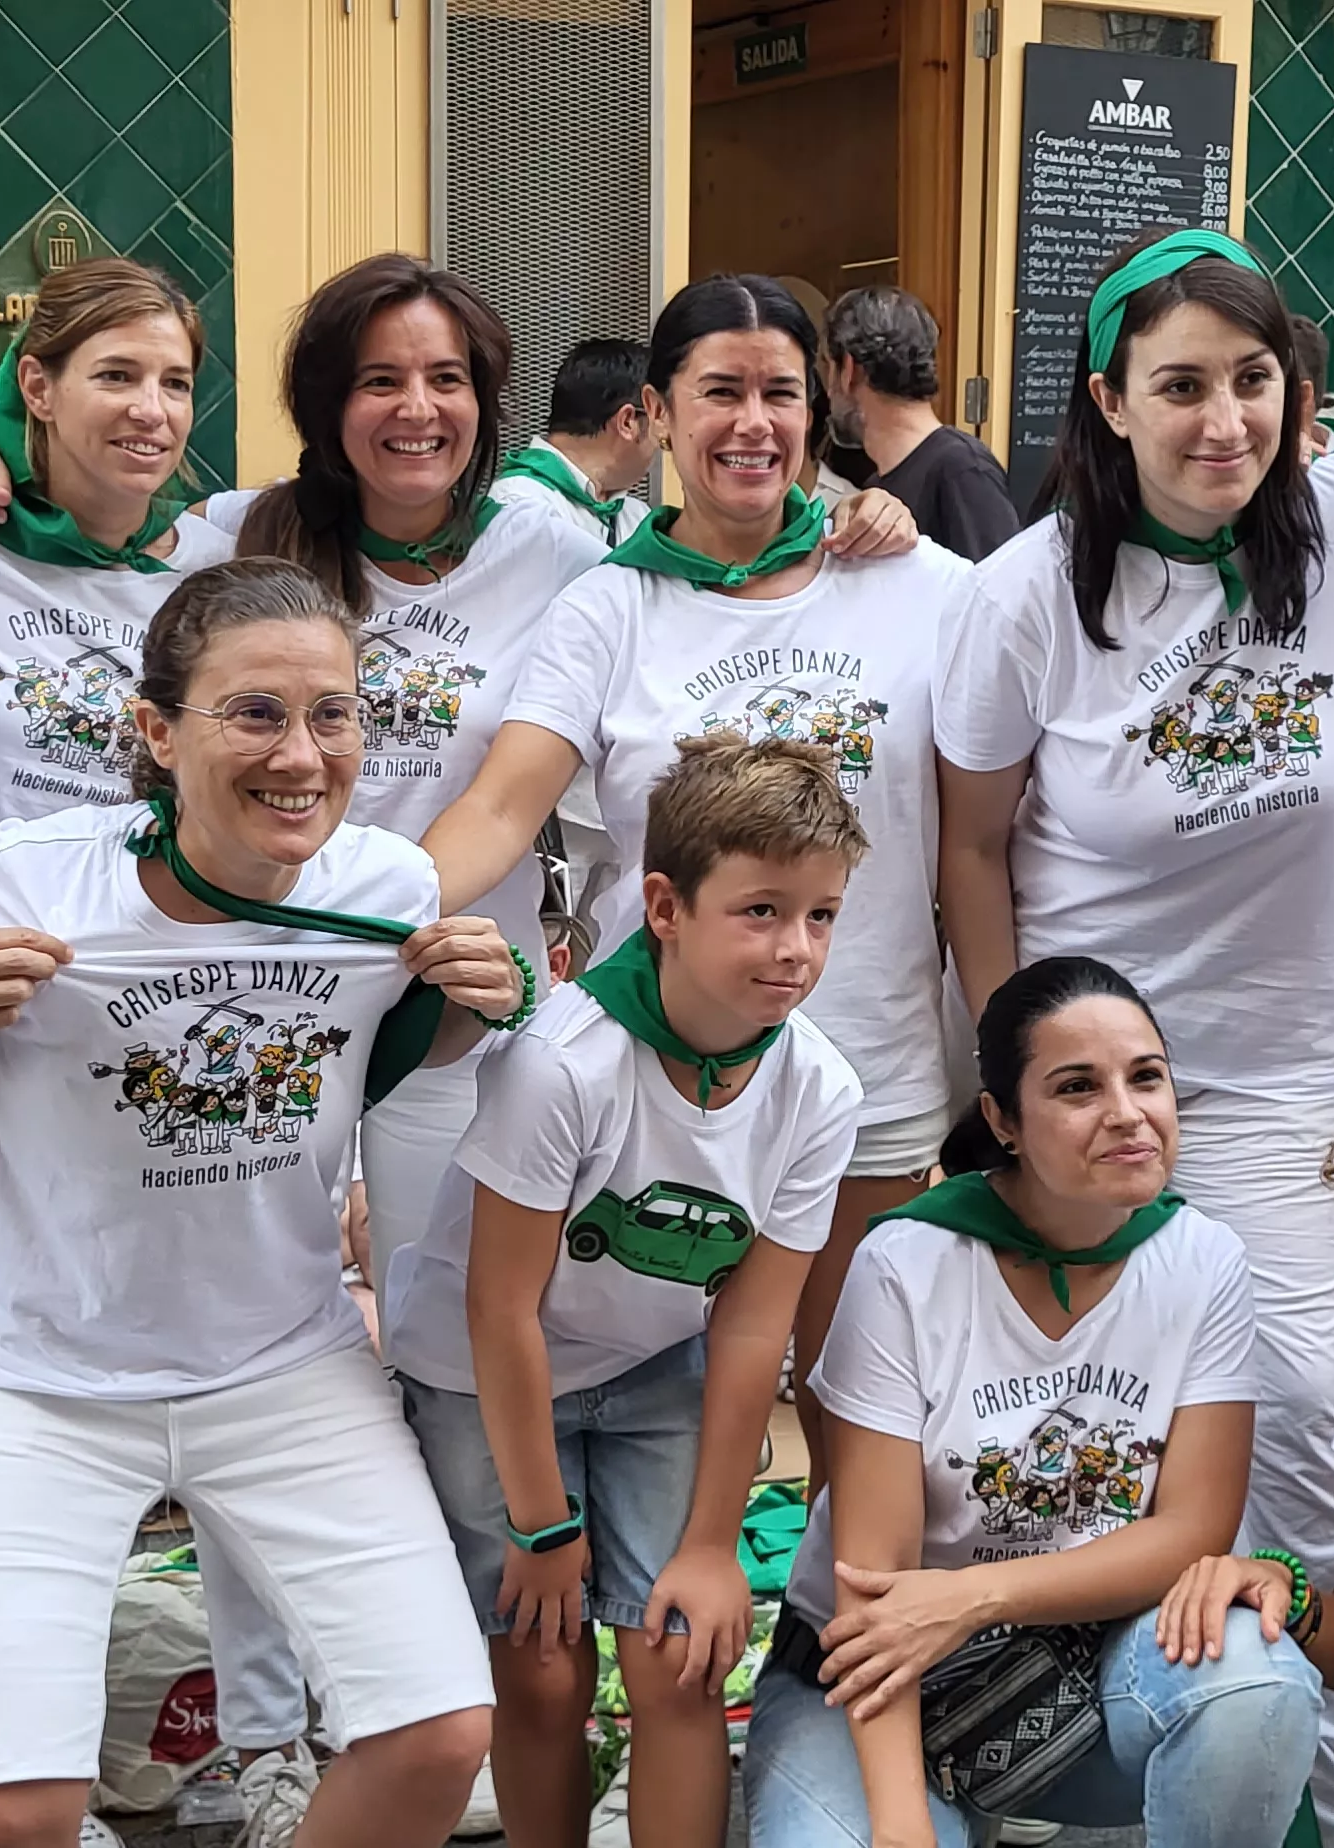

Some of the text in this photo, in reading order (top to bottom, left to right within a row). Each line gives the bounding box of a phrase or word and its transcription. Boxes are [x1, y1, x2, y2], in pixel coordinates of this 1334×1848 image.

[741, 34, 798, 72] SALIDA
[1088, 99, 1173, 130] AMBAR
[1035, 130, 1086, 152] Croquetas
[8, 607, 114, 642] CRISESPE
[403, 603, 470, 648] DANZA
[683, 647, 863, 702] CRISESPE DANZA
[10, 767, 83, 798] Haciendo
[384, 757, 442, 779] historia
[1174, 784, 1321, 835] Haciendo historia
[106, 959, 342, 1030] CRISESPE DANZA
[142, 1150, 302, 1190] Haciendo historia
[1076, 1362, 1151, 1414] DANZA
